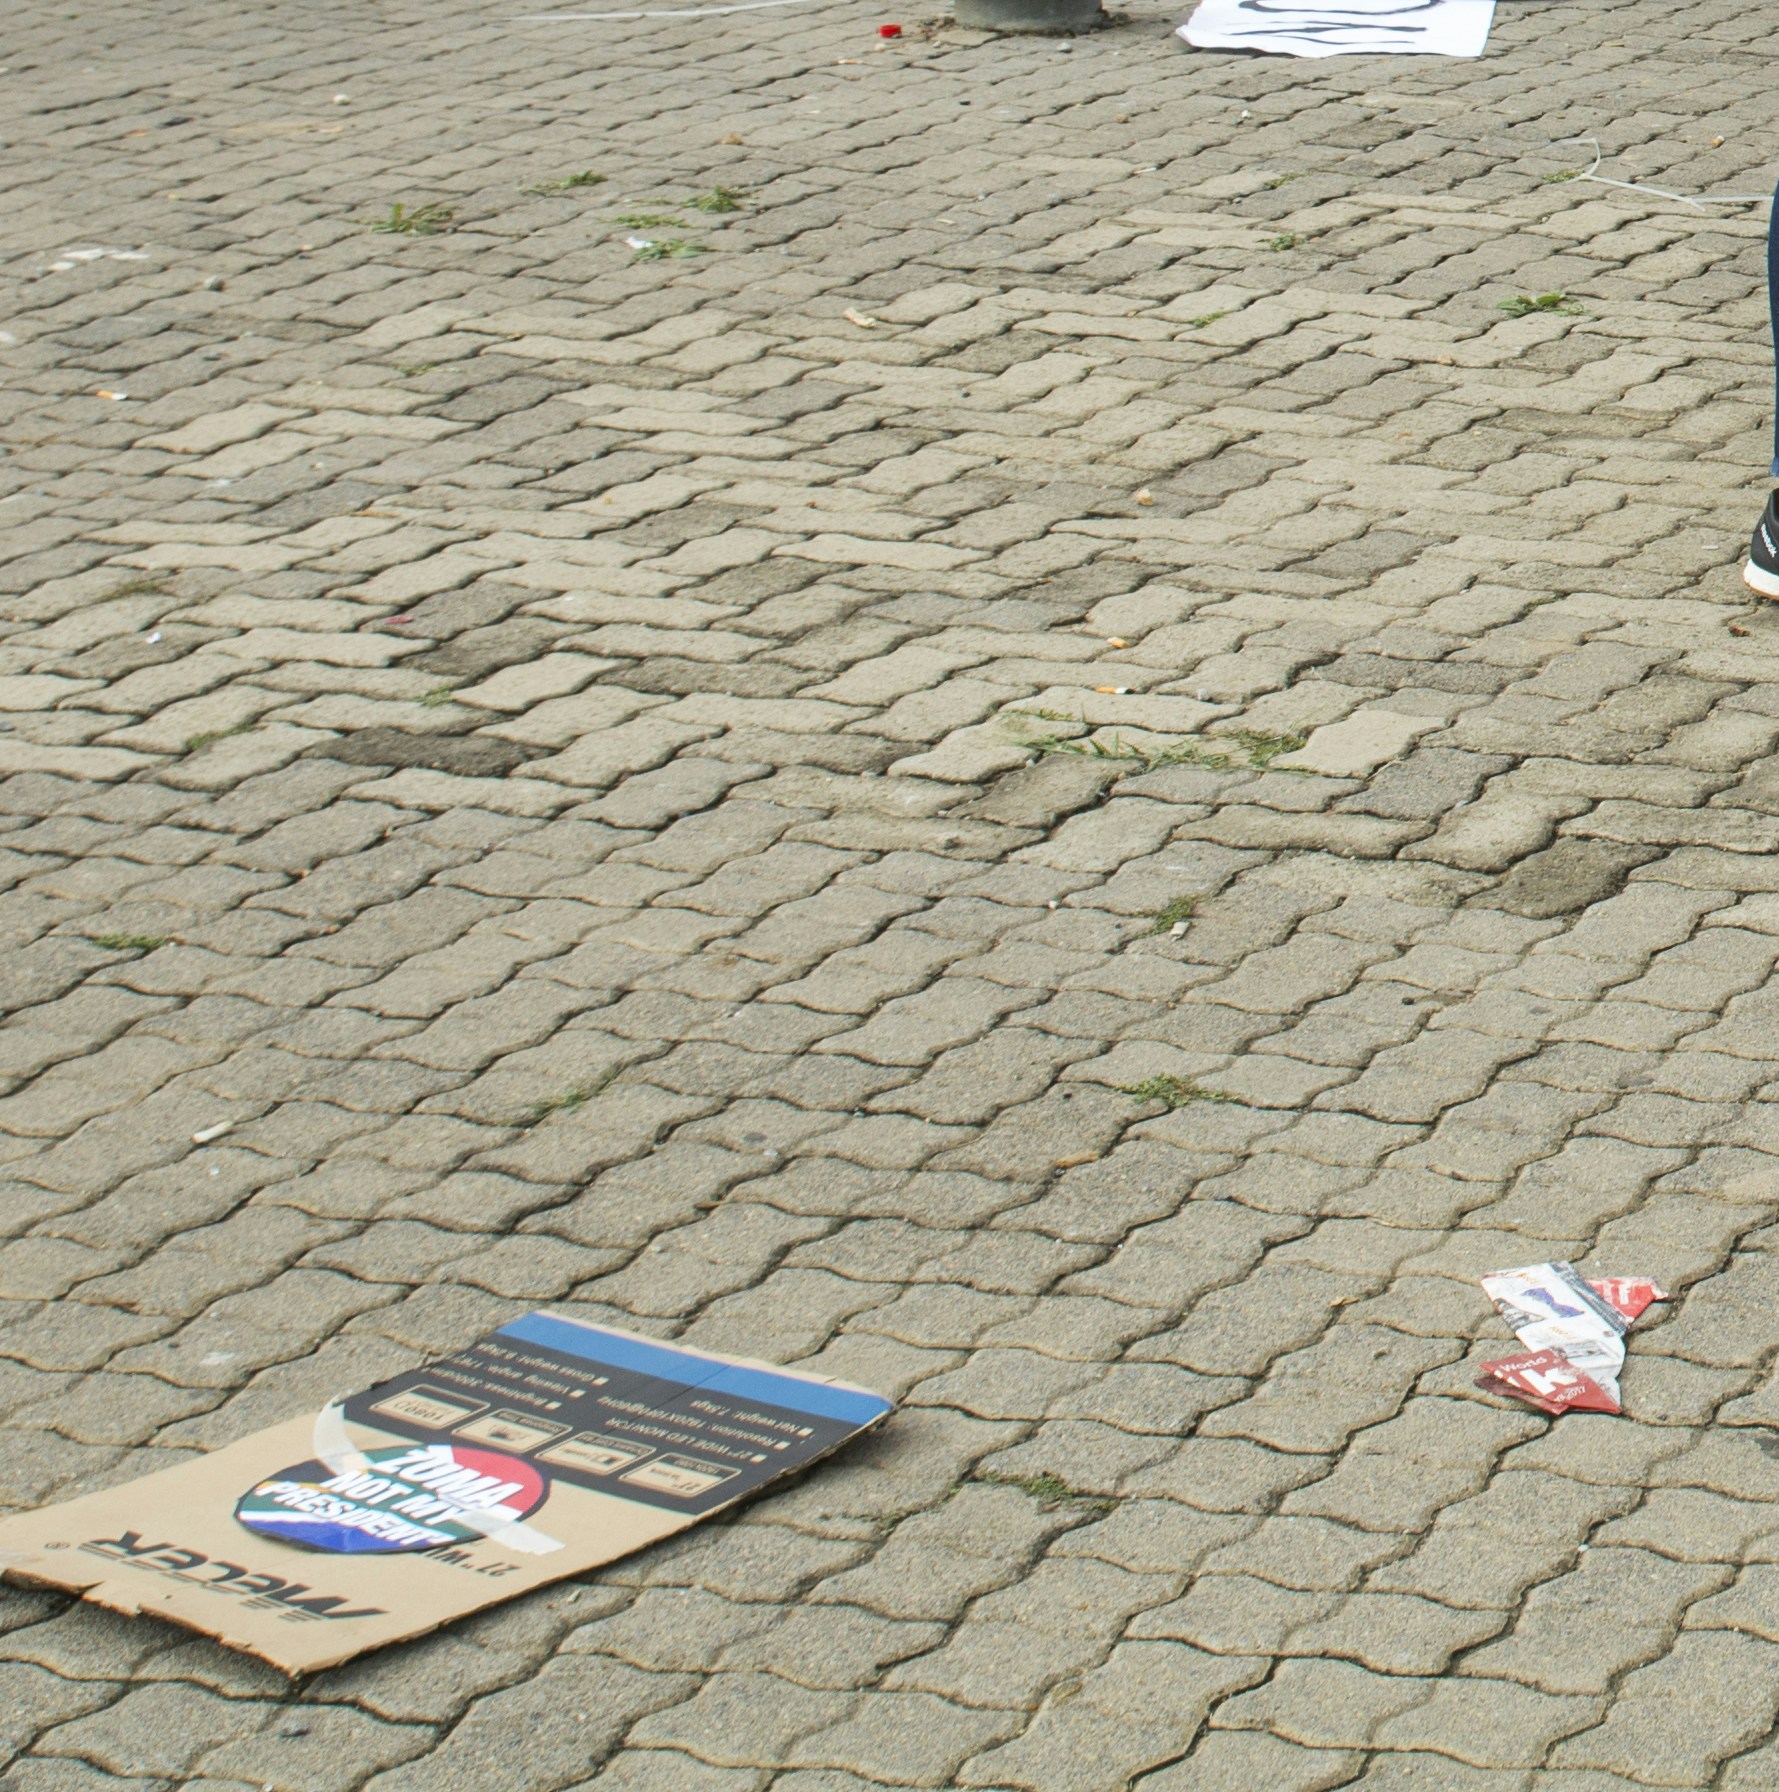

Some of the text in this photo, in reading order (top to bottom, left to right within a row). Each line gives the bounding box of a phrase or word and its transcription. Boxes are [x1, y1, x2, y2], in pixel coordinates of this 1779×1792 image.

[322, 1470, 470, 1522] NOT MY
[380, 1444, 523, 1509] ZUMA
[256, 1481, 453, 1548] PRESIDENT
[78, 1530, 388, 1622] MECER
